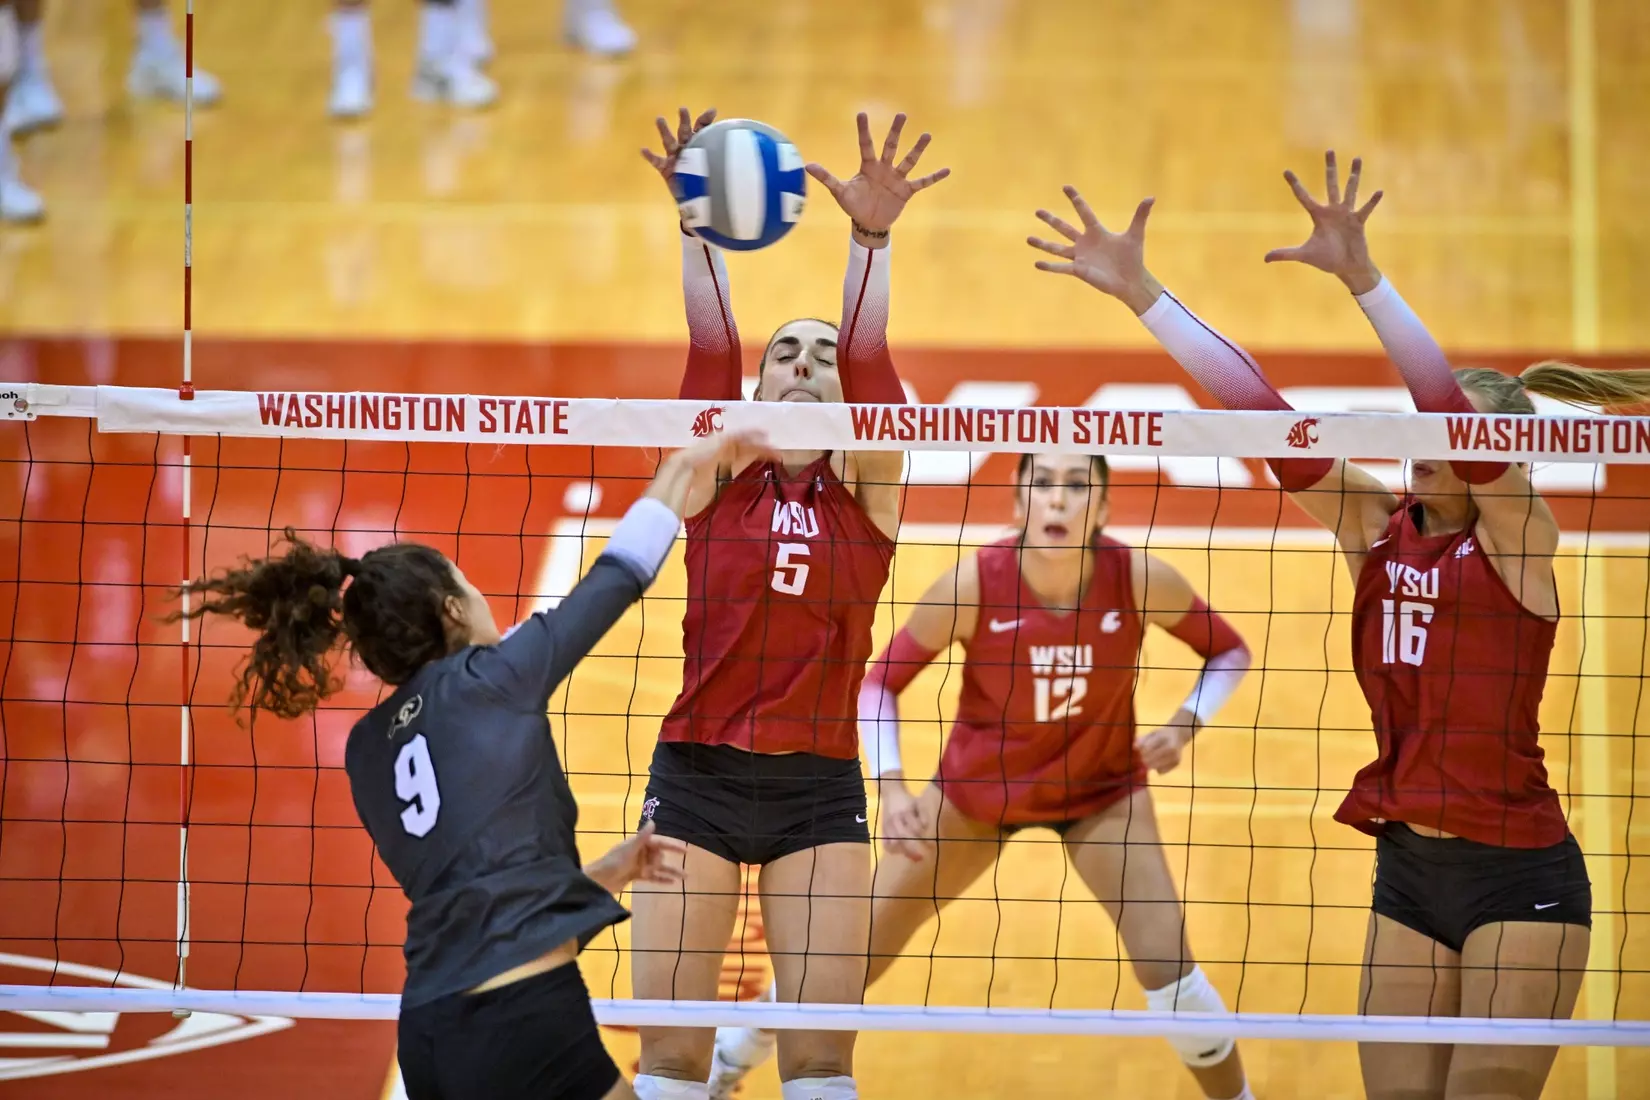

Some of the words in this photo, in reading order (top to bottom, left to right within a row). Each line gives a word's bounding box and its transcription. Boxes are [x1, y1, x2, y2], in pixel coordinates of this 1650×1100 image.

[258, 392, 465, 432] WASHINGTON
[479, 400, 569, 435] STATE
[852, 406, 1059, 443] WASHINGTON
[1073, 411, 1163, 446] STATE
[1446, 416, 1650, 453] WASHINGTON
[771, 499, 820, 538] WSU
[770, 542, 811, 596] 5
[1381, 599, 1435, 667] 16
[1029, 644, 1094, 675] WSU
[1033, 677, 1088, 722] 12
[394, 733, 441, 838] 9
